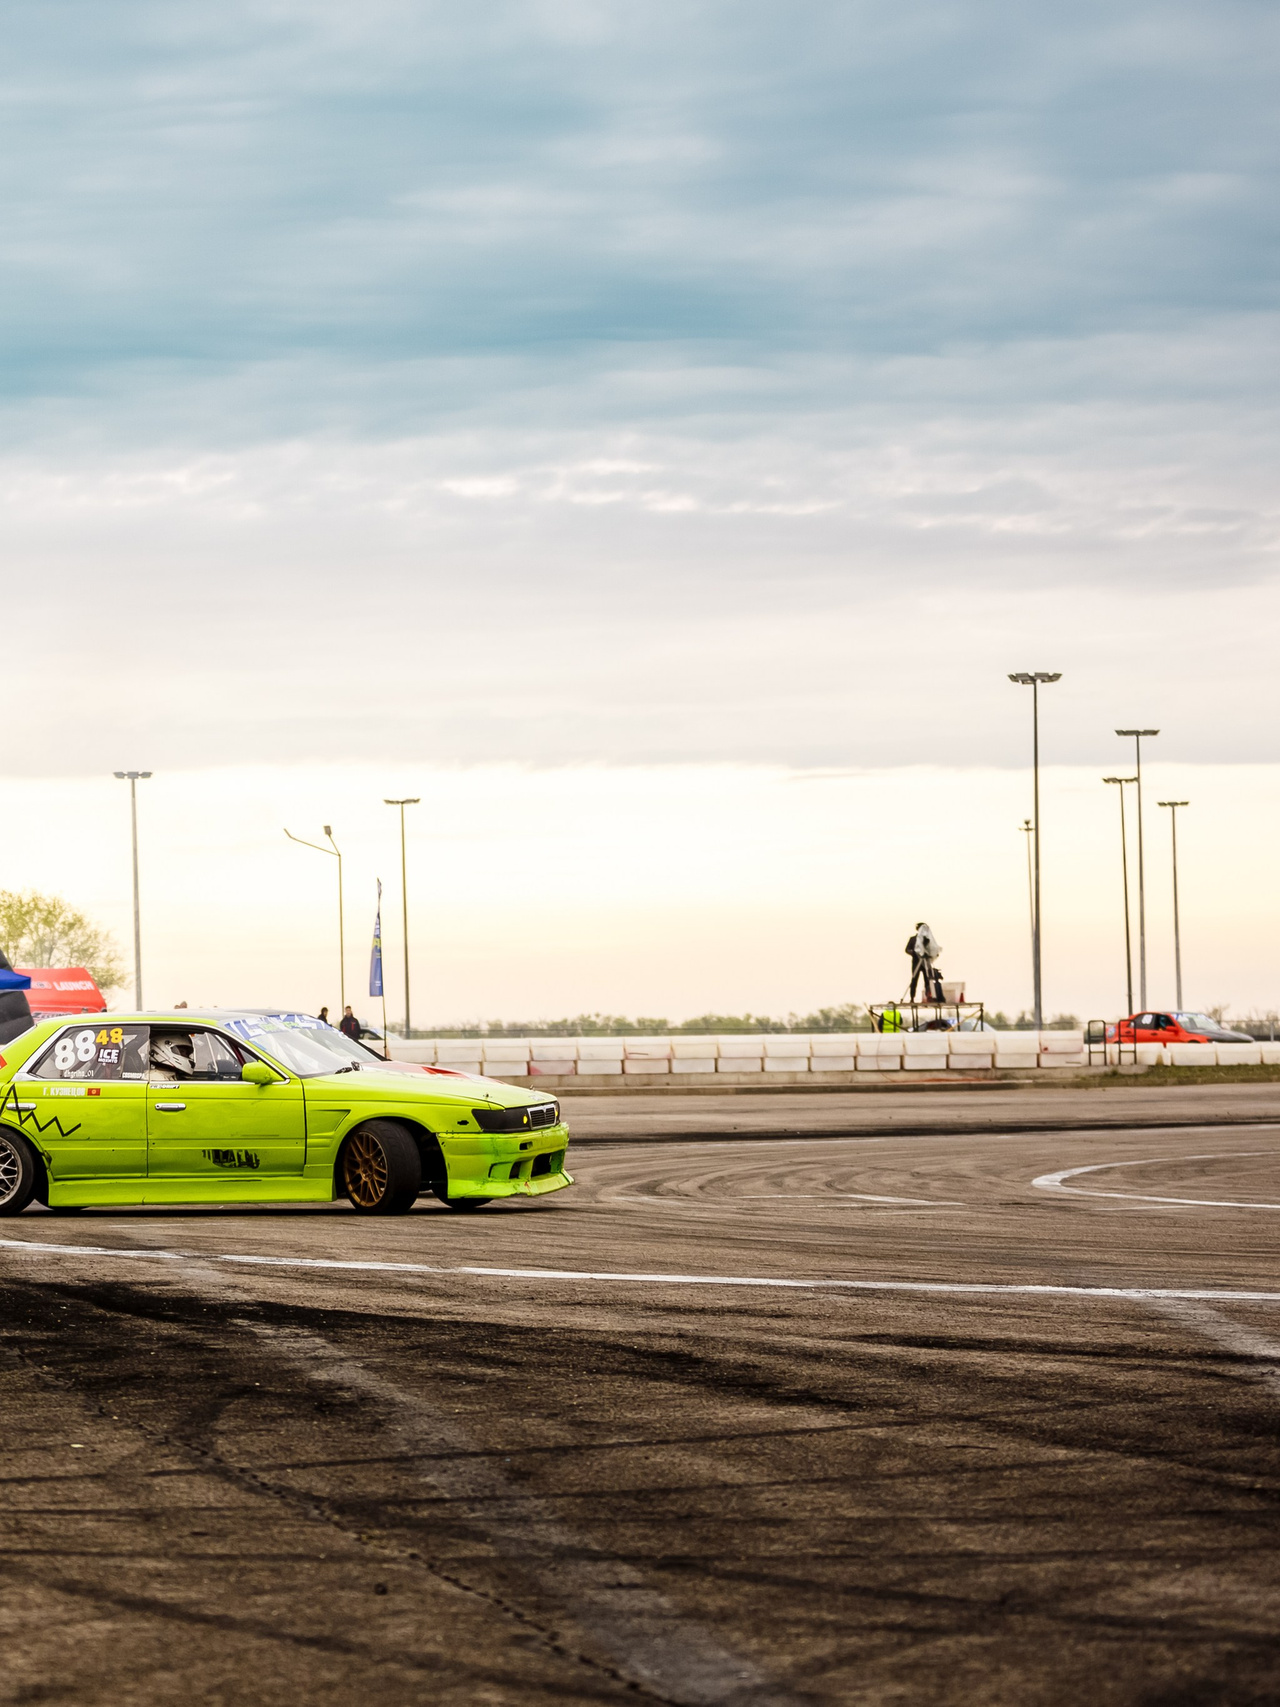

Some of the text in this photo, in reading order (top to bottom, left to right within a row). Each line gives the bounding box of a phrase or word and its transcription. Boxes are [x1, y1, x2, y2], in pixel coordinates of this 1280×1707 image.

[53, 981, 95, 991] LAUNCH
[95, 1027, 123, 1046] 48
[54, 1029, 97, 1070] 88
[99, 1048, 120, 1059] ICE
[50, 1087, 86, 1097] КУЗНЕЦОВ
